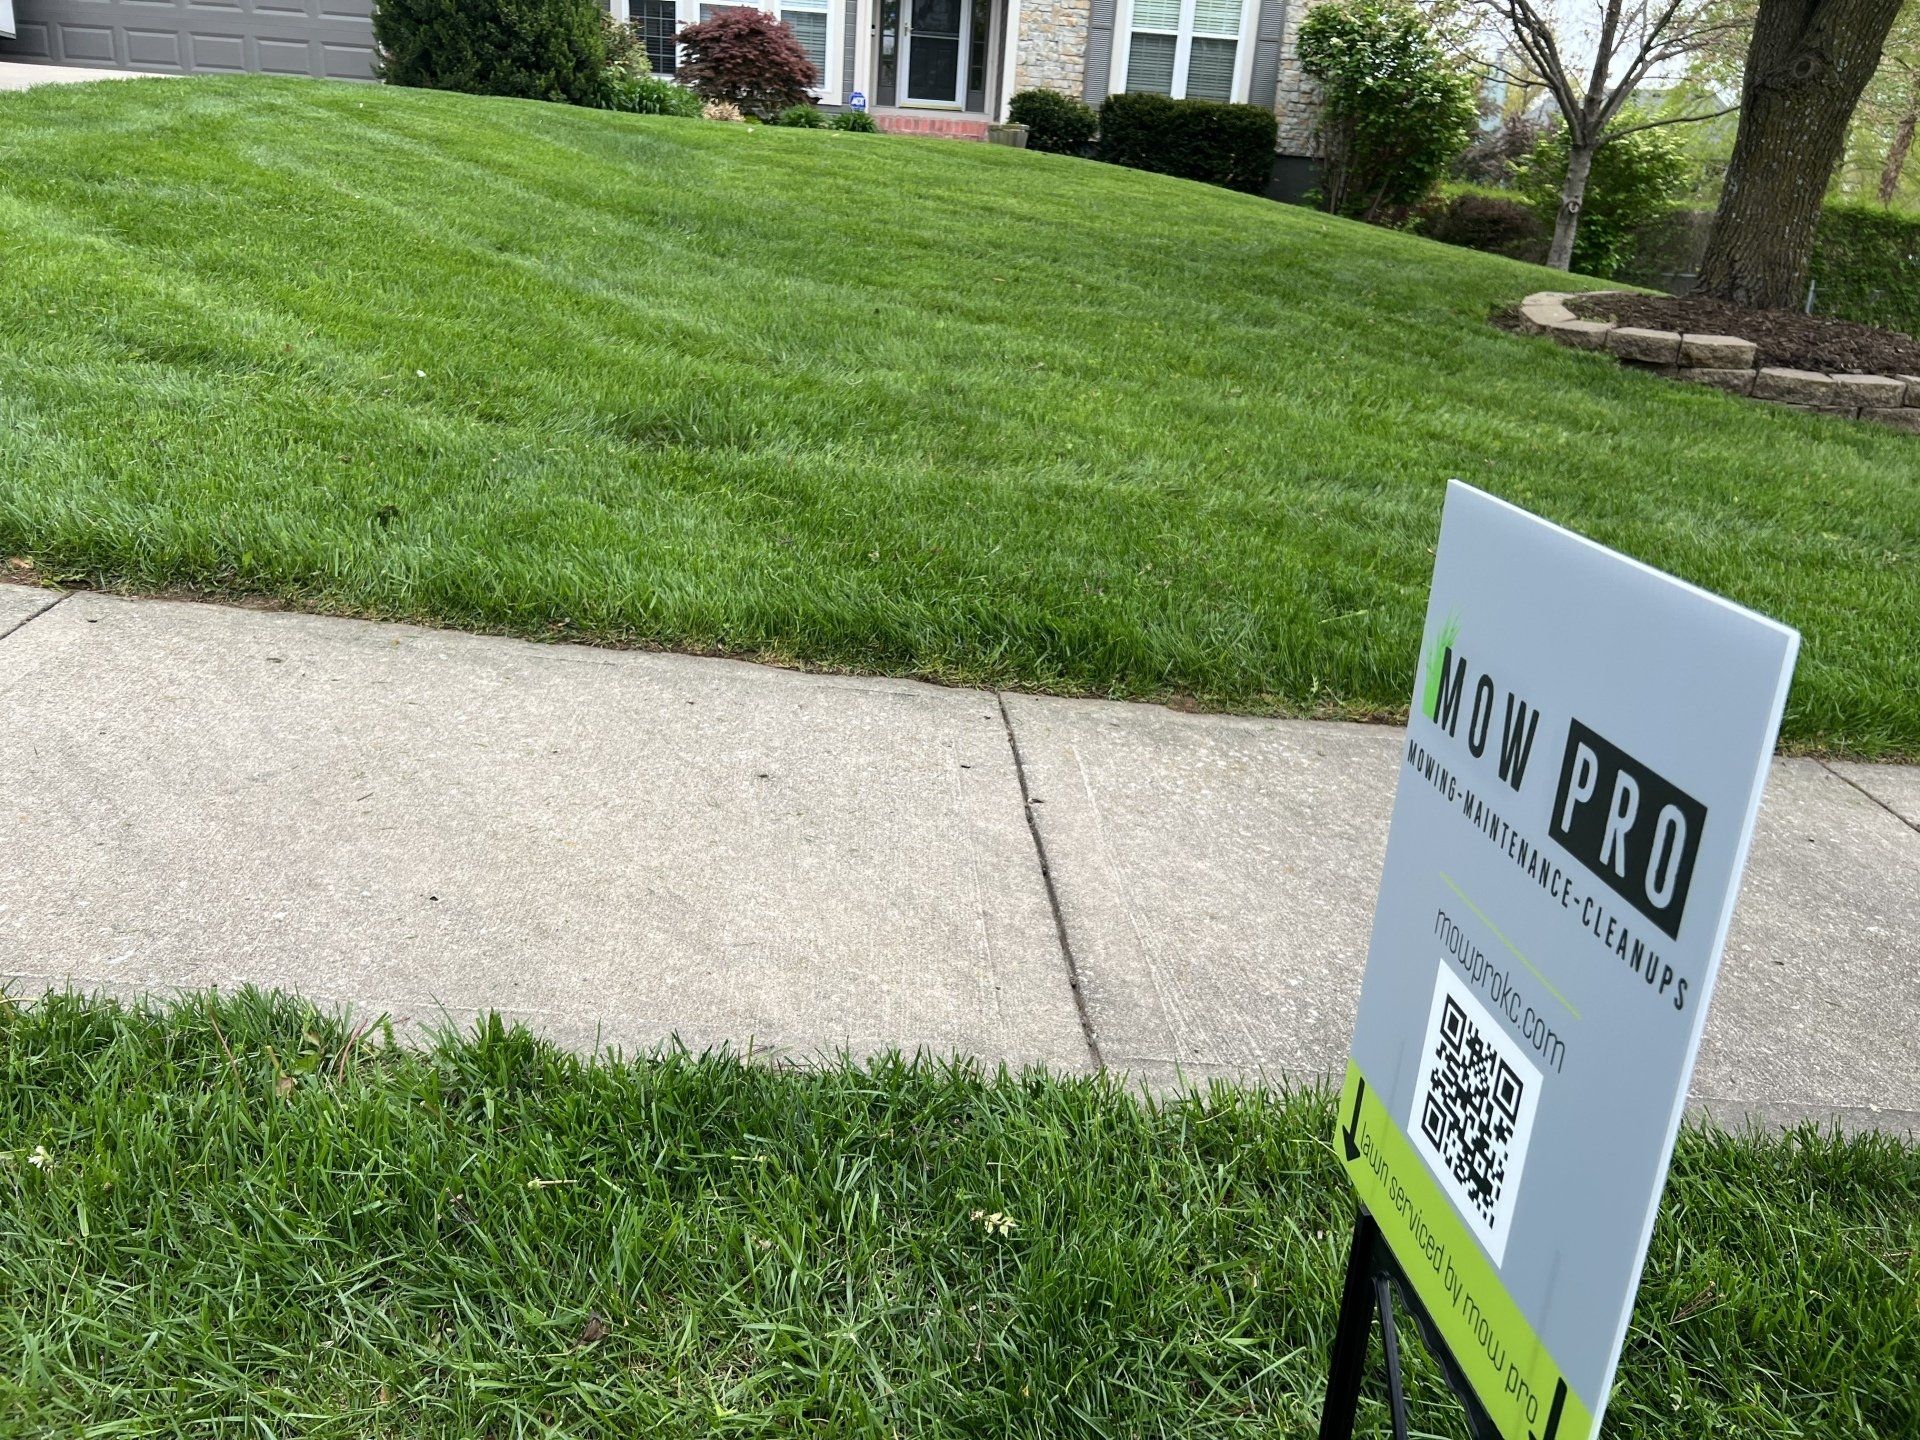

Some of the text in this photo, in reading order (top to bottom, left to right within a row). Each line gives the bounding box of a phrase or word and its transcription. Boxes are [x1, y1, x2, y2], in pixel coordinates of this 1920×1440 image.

[1433, 646, 1688, 909] MOW PRO
[1434, 908, 1565, 1074] mowprokc.com
[1359, 1121, 1539, 1425] lawn serviced by mow pro
